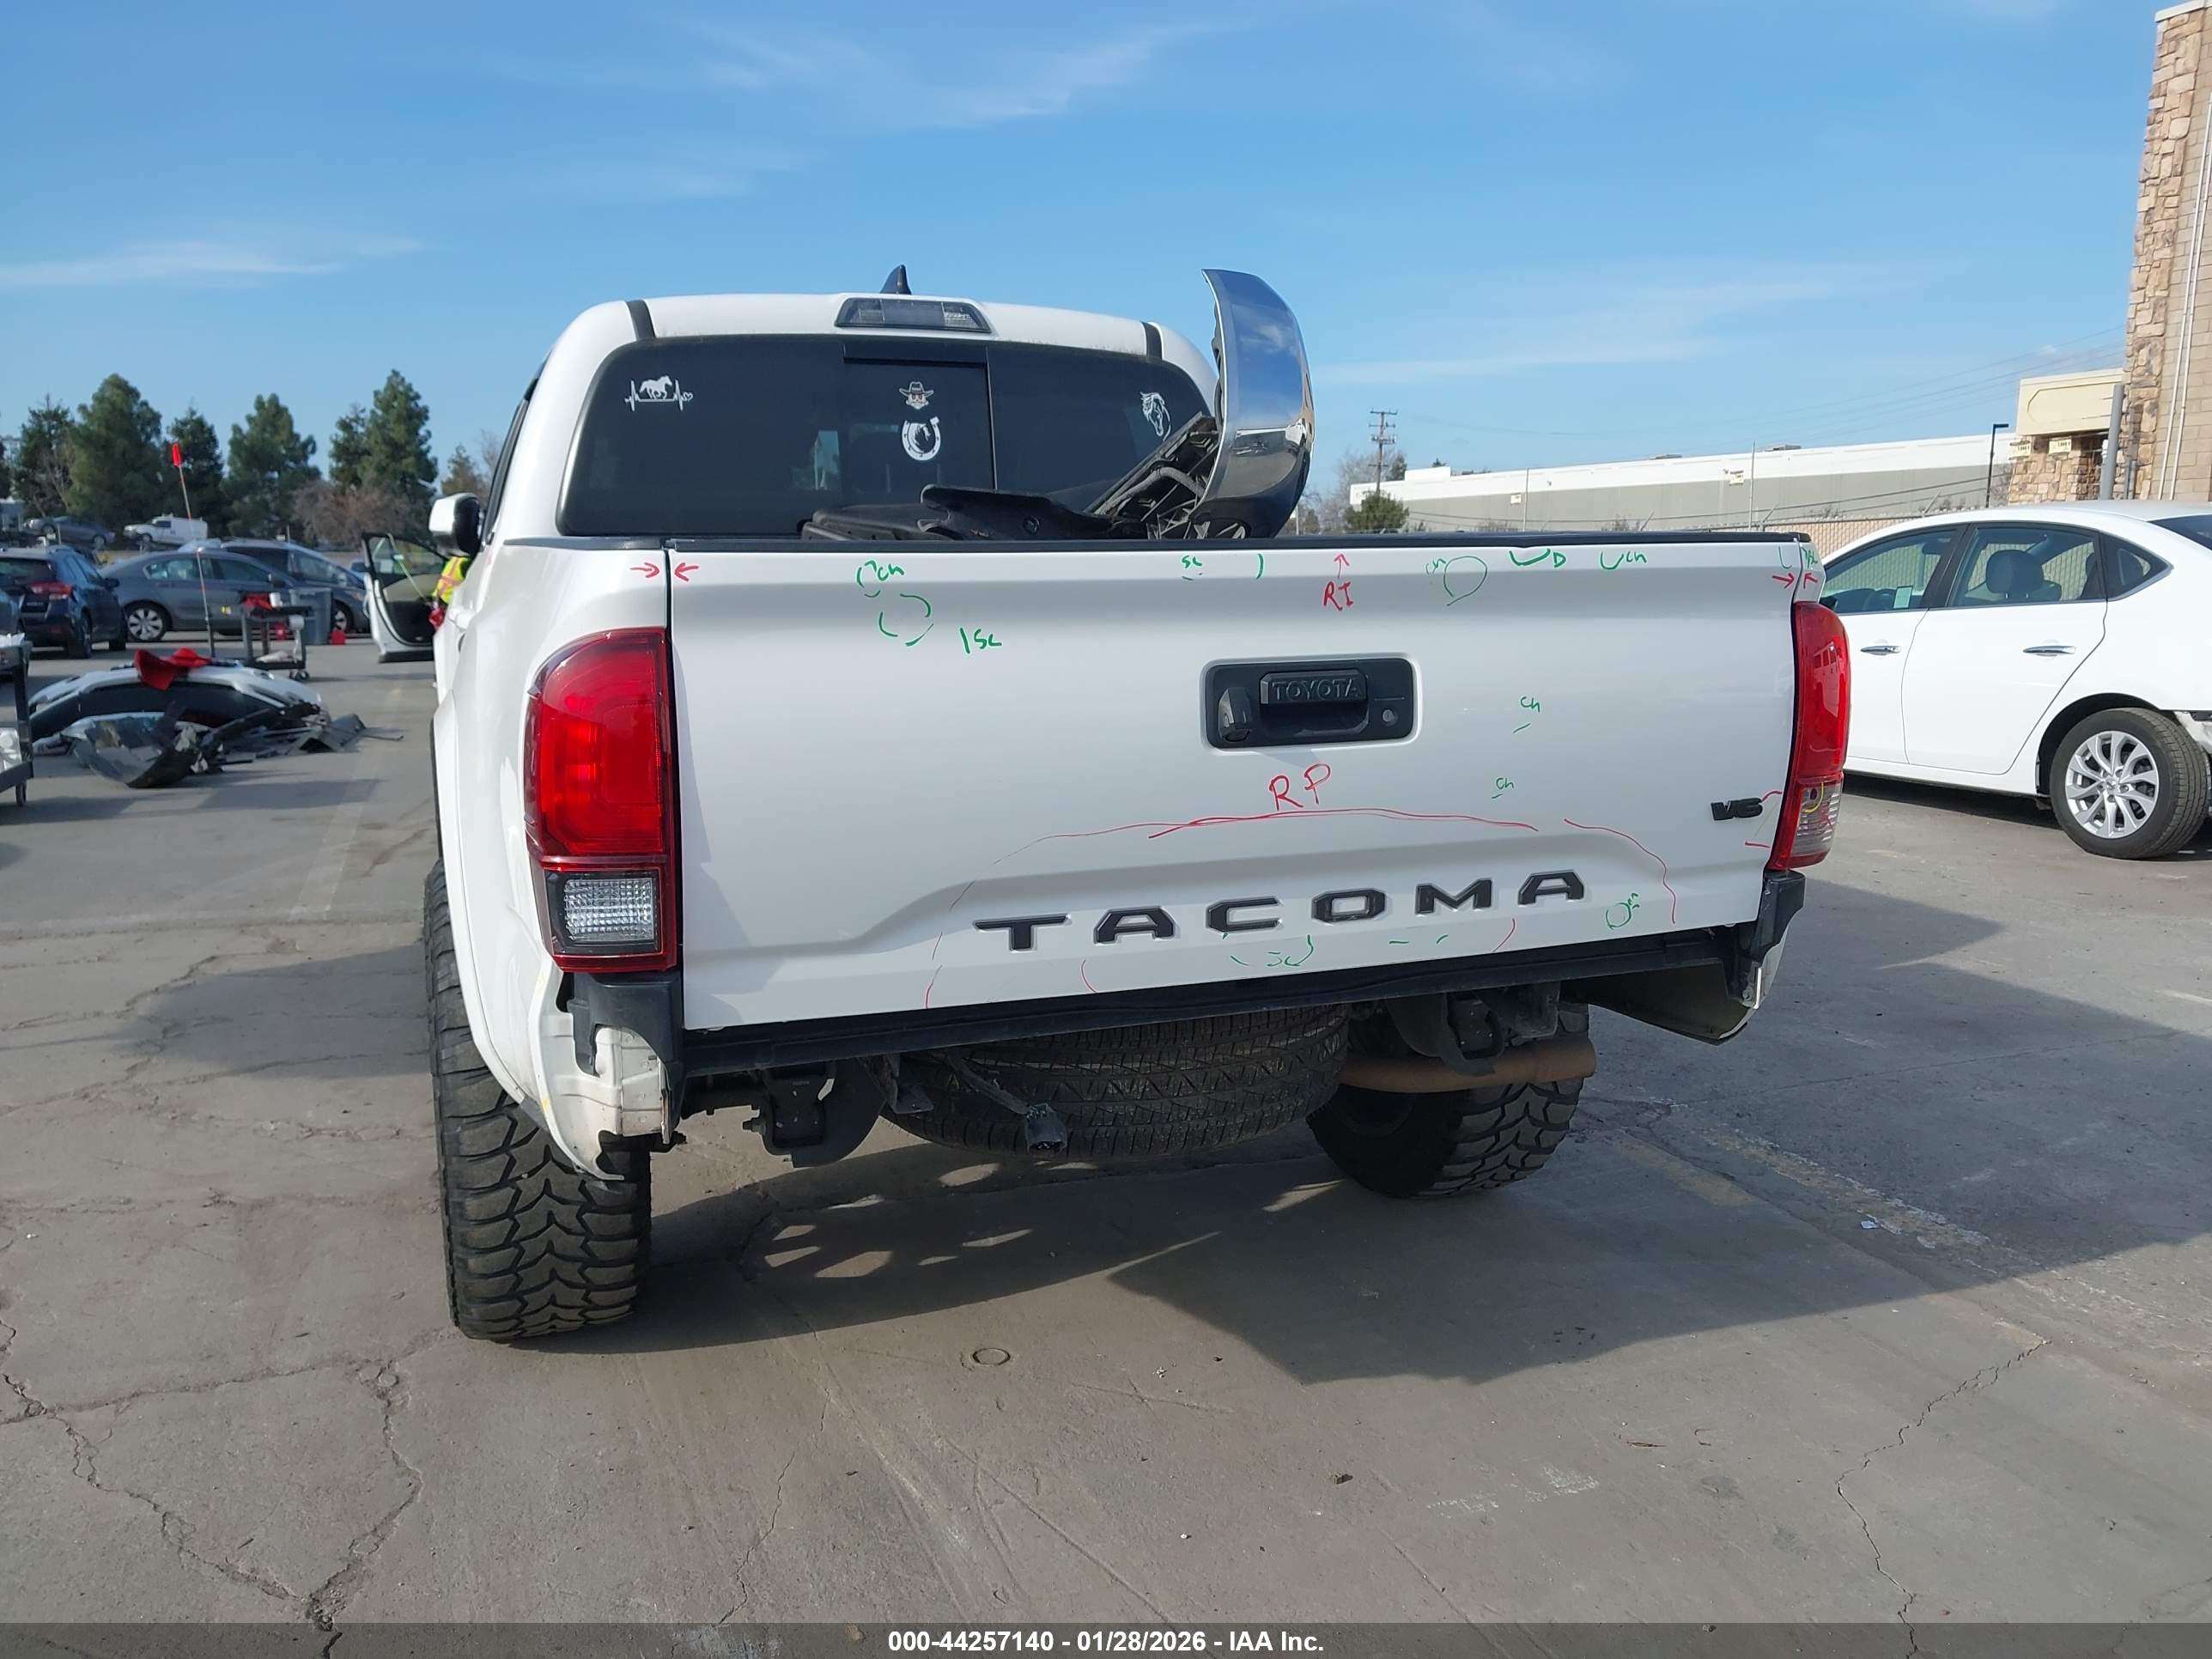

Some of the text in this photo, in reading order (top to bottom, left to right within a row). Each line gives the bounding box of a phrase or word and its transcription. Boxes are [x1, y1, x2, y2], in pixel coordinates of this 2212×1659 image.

[1271, 678, 1364, 702] TOYOTA
[1711, 797, 1763, 821] V6
[973, 870, 1584, 951] TACOMA
